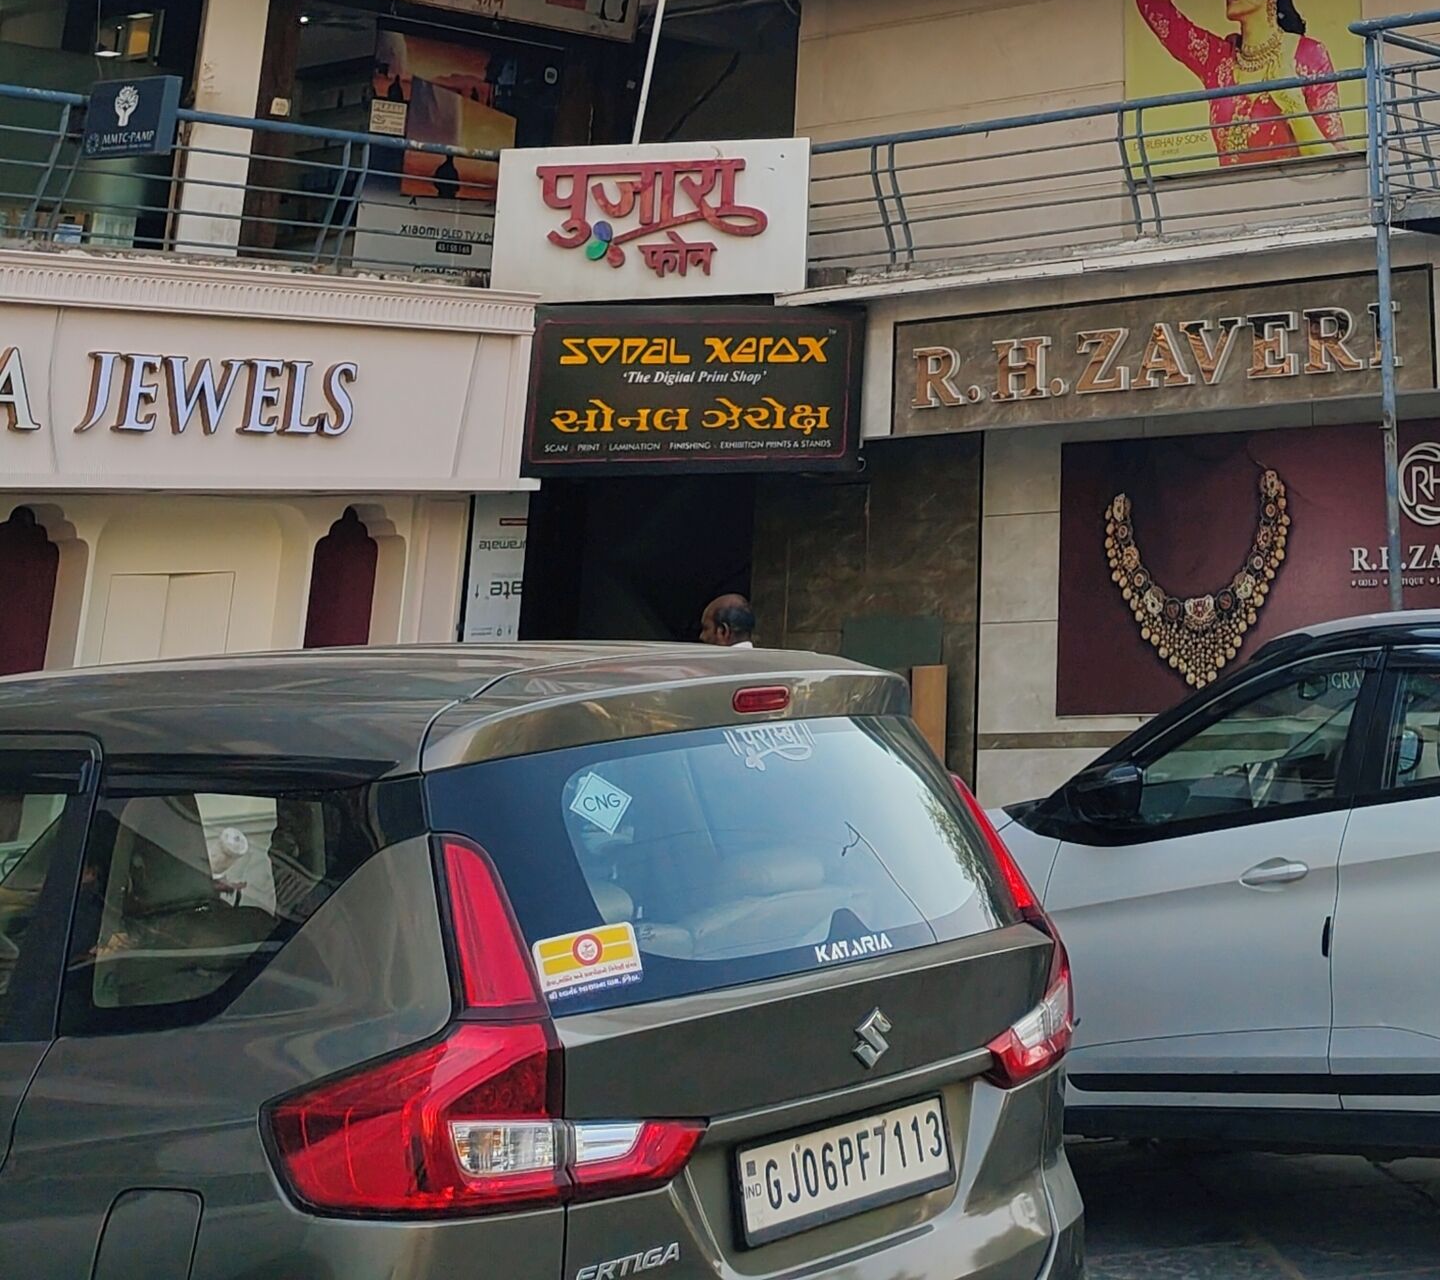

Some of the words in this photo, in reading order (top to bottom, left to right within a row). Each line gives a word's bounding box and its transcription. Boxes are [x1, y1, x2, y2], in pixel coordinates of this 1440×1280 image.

[536, 158, 768, 249] पुजारा
[638, 231, 717, 278] फोन
[653, 369, 694, 385] Digital
[698, 369, 729, 384] Print
[75, 351, 359, 439] JEWELS
[551, 399, 689, 432] સોનલ
[544, 444, 568, 452] SCAN
[609, 443, 660, 451] LAMINATION
[670, 442, 710, 450] FINISHING
[801, 440, 831, 448] STANDS
[582, 792, 622, 812] CNG
[816, 932, 893, 963] KATARIA
[764, 1112, 944, 1211] GJ06PF7113
[745, 1183, 761, 1200] IND
[576, 1241, 680, 1280] ERTIGA
